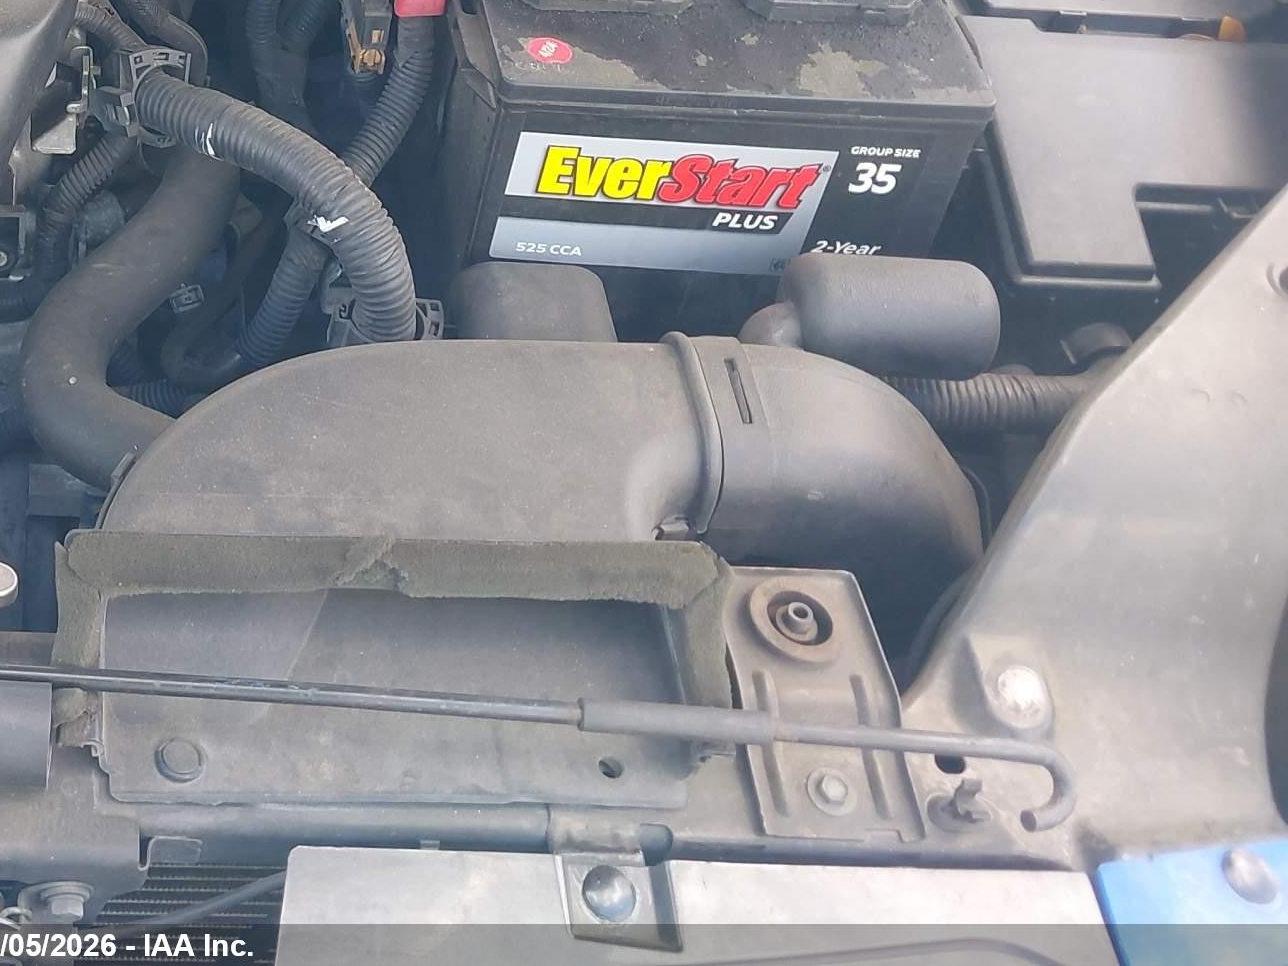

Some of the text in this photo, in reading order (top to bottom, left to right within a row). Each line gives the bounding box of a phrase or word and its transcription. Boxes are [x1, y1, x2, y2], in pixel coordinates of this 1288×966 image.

[850, 145, 921, 159] GROUP SIZE
[535, 144, 821, 209] EverStart
[847, 161, 902, 195] 35
[711, 212, 778, 230] PLUS
[515, 241, 583, 257] 525 CCA
[810, 240, 882, 256] 2-Year
